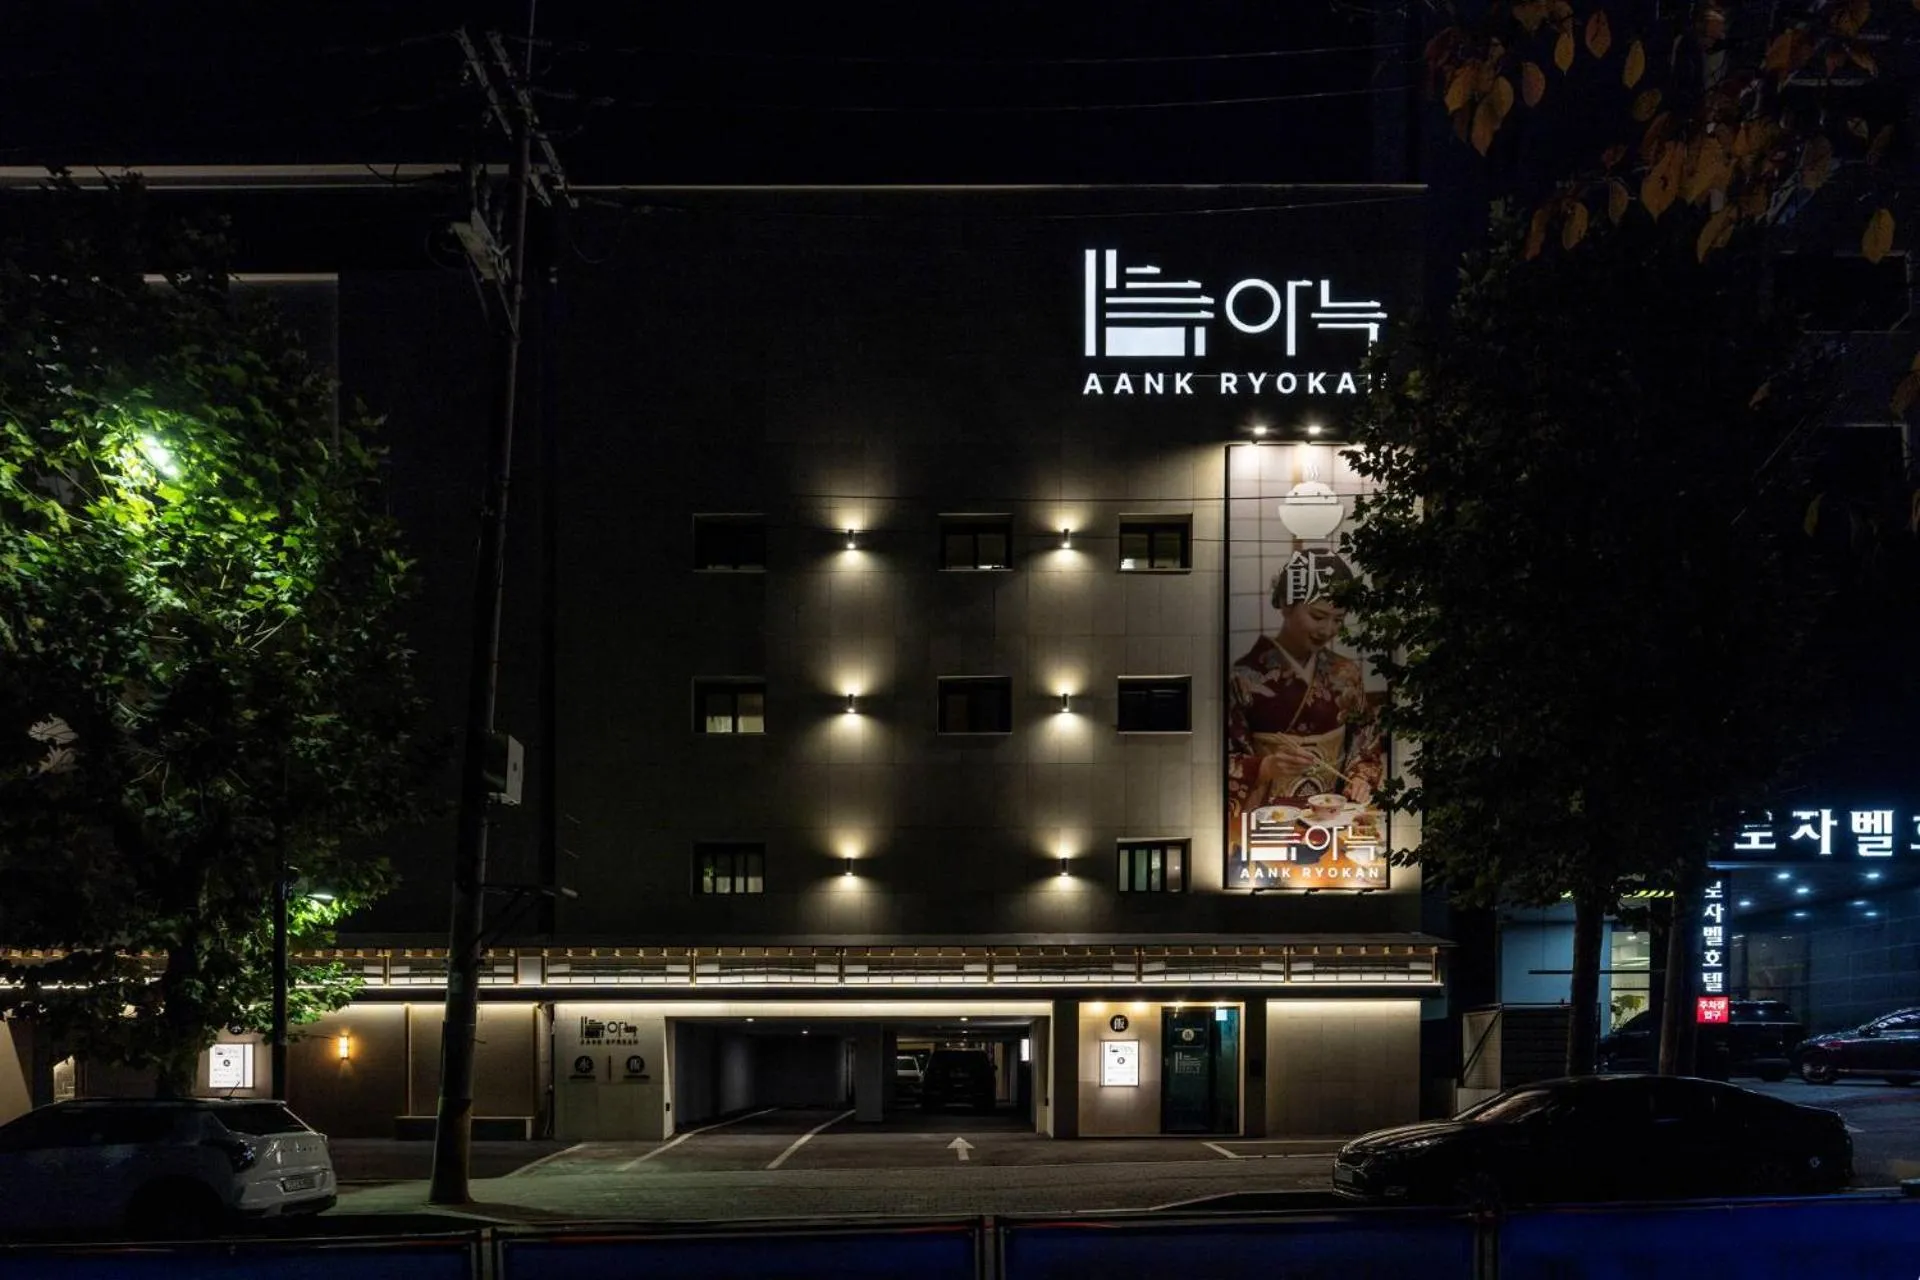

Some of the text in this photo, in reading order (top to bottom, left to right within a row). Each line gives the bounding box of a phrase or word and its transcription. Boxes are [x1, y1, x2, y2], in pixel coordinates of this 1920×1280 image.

[1083, 371, 1387, 395] AANK RYOKA
[1240, 867, 1379, 879] AANK RYOKAN
